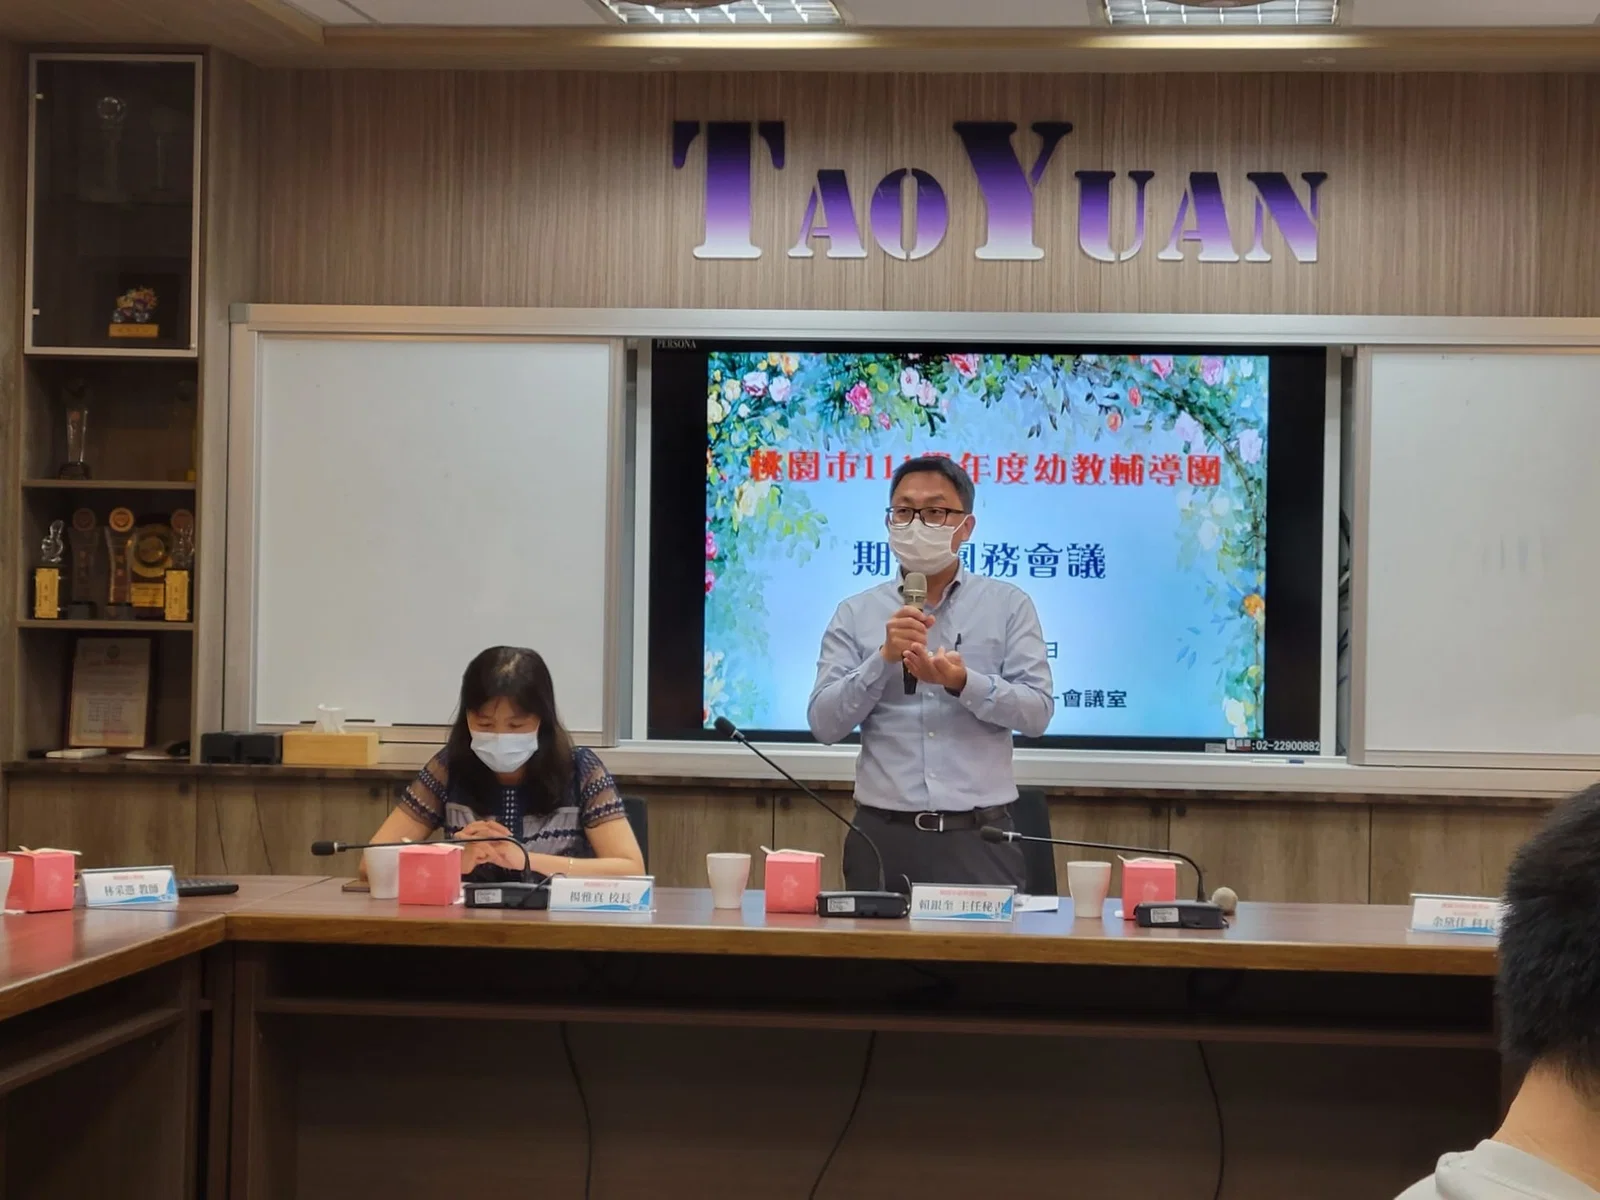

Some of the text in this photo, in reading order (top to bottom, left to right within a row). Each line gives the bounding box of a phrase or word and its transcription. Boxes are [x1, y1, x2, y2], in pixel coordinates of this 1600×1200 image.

[656, 338, 697, 349] PERSONA
[750, 449, 1222, 487] 桃園市11年度幼教輔導團
[852, 540, 1107, 579] 期務會議
